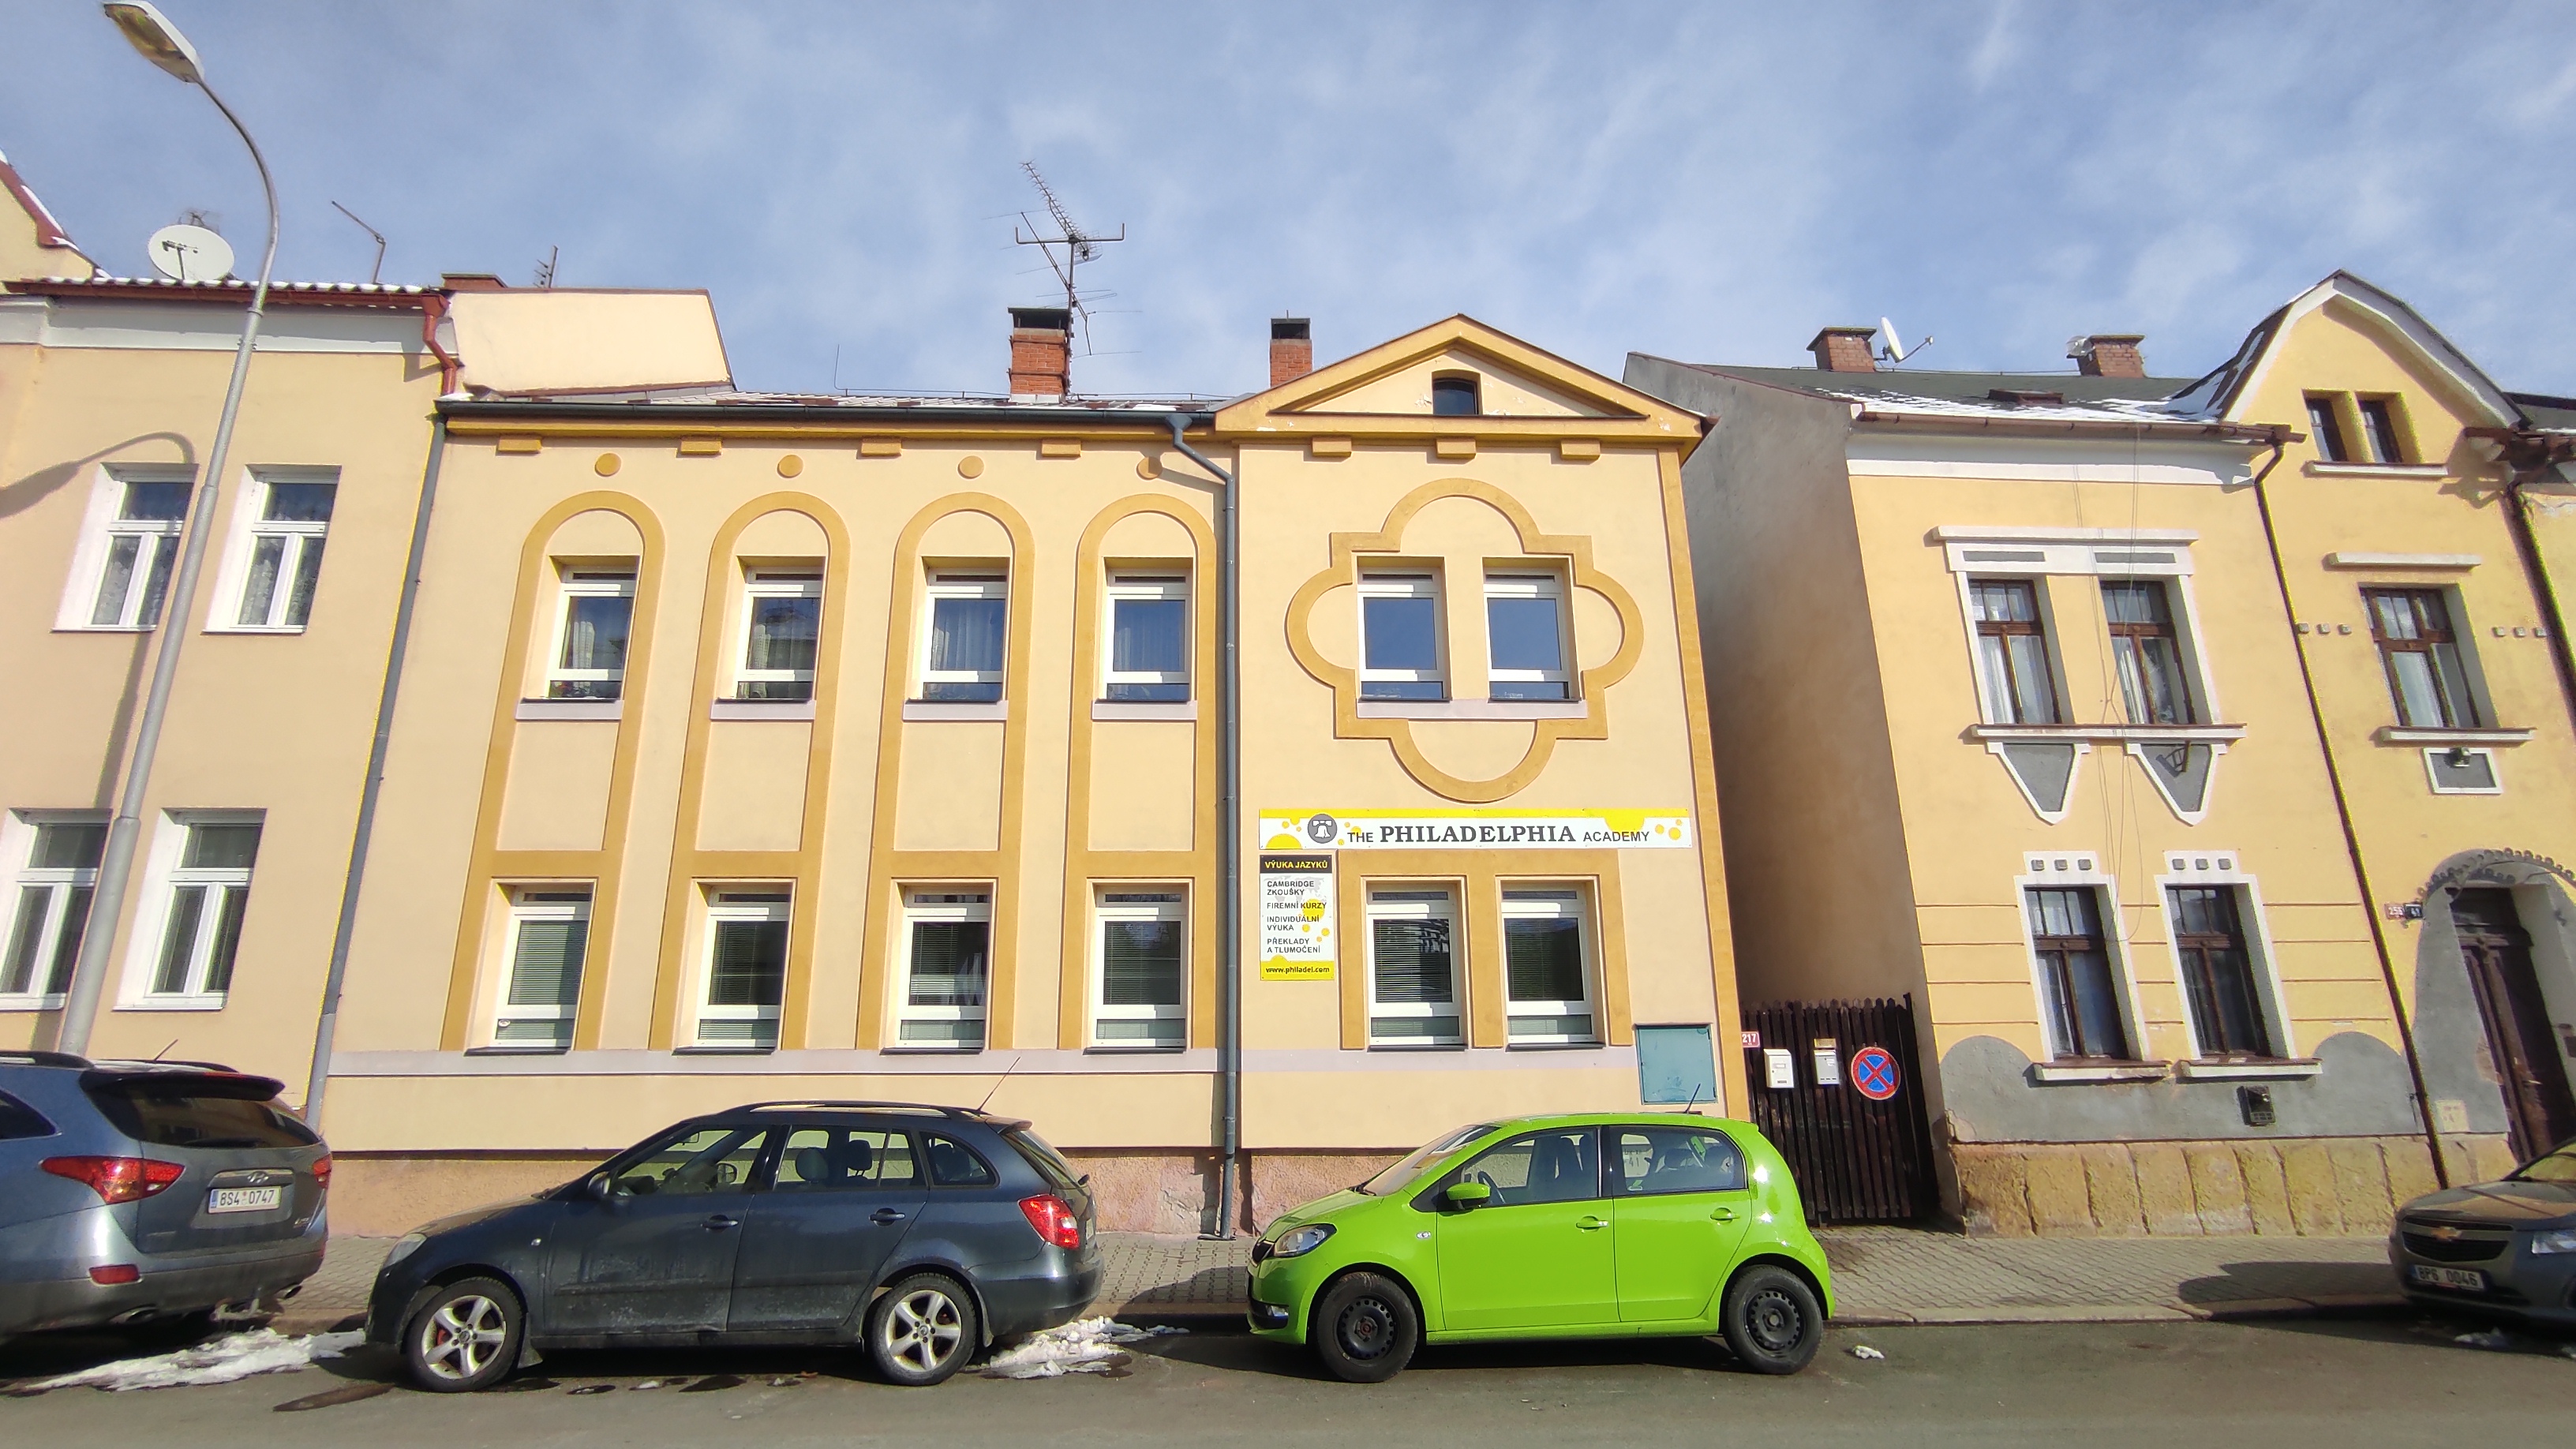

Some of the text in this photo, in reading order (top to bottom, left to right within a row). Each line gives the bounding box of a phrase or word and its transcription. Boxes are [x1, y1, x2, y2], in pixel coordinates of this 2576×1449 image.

[1347, 826, 1650, 843] THE PHILADELPHIA ACADEMY
[1264, 859, 1328, 869] VÝUKA JAZYKŮ
[1267, 900, 1299, 909] FIREMNÍ
[1275, 945, 1320, 953] TLUMOČENÍ
[1266, 966, 1330, 975] www.philadel.com
[1742, 1033, 1757, 1043] 217
[219, 1189, 275, 1206] 8S4 0747
